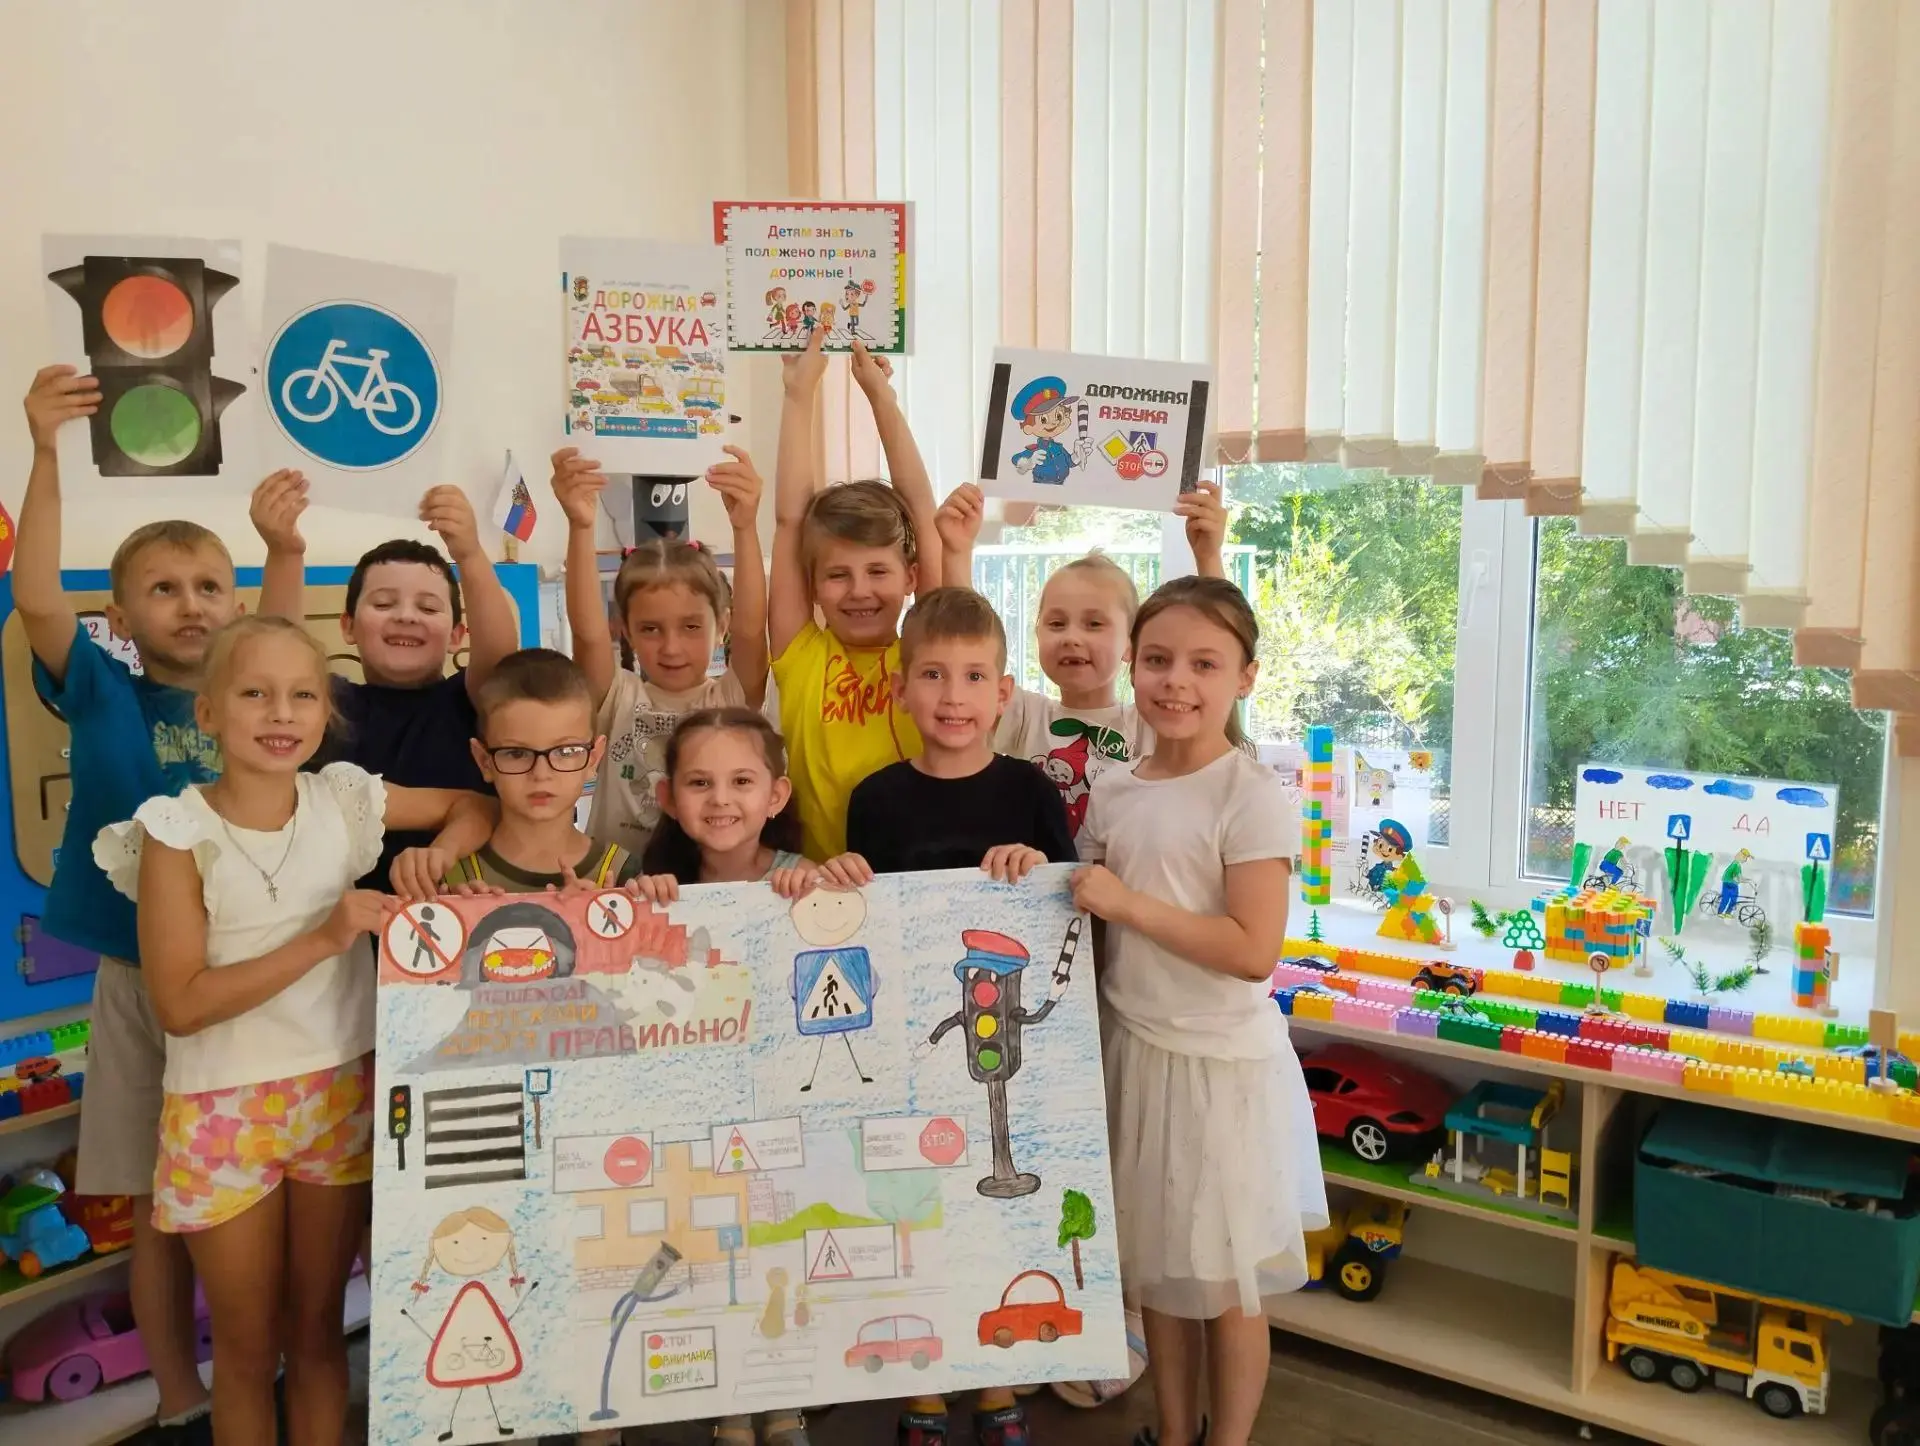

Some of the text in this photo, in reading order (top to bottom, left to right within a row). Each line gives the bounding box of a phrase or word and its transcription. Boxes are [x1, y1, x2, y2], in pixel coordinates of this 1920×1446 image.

[767, 225, 853, 239] Детям знать
[745, 246, 876, 261] положено правила
[770, 266, 844, 281] дорожные
[593, 290, 696, 312] ДОРОЖНАЯ
[581, 313, 709, 347] АЗБУКА
[1085, 383, 1188, 405] ДОРОЖНАЯ
[1099, 405, 1168, 425] АЗБУКА
[1599, 799, 1645, 821] НЕТ
[1732, 813, 1770, 835] ДА
[548, 999, 752, 1058] ПРАВИЛЬНО!
[922, 1130, 957, 1148] STOP
